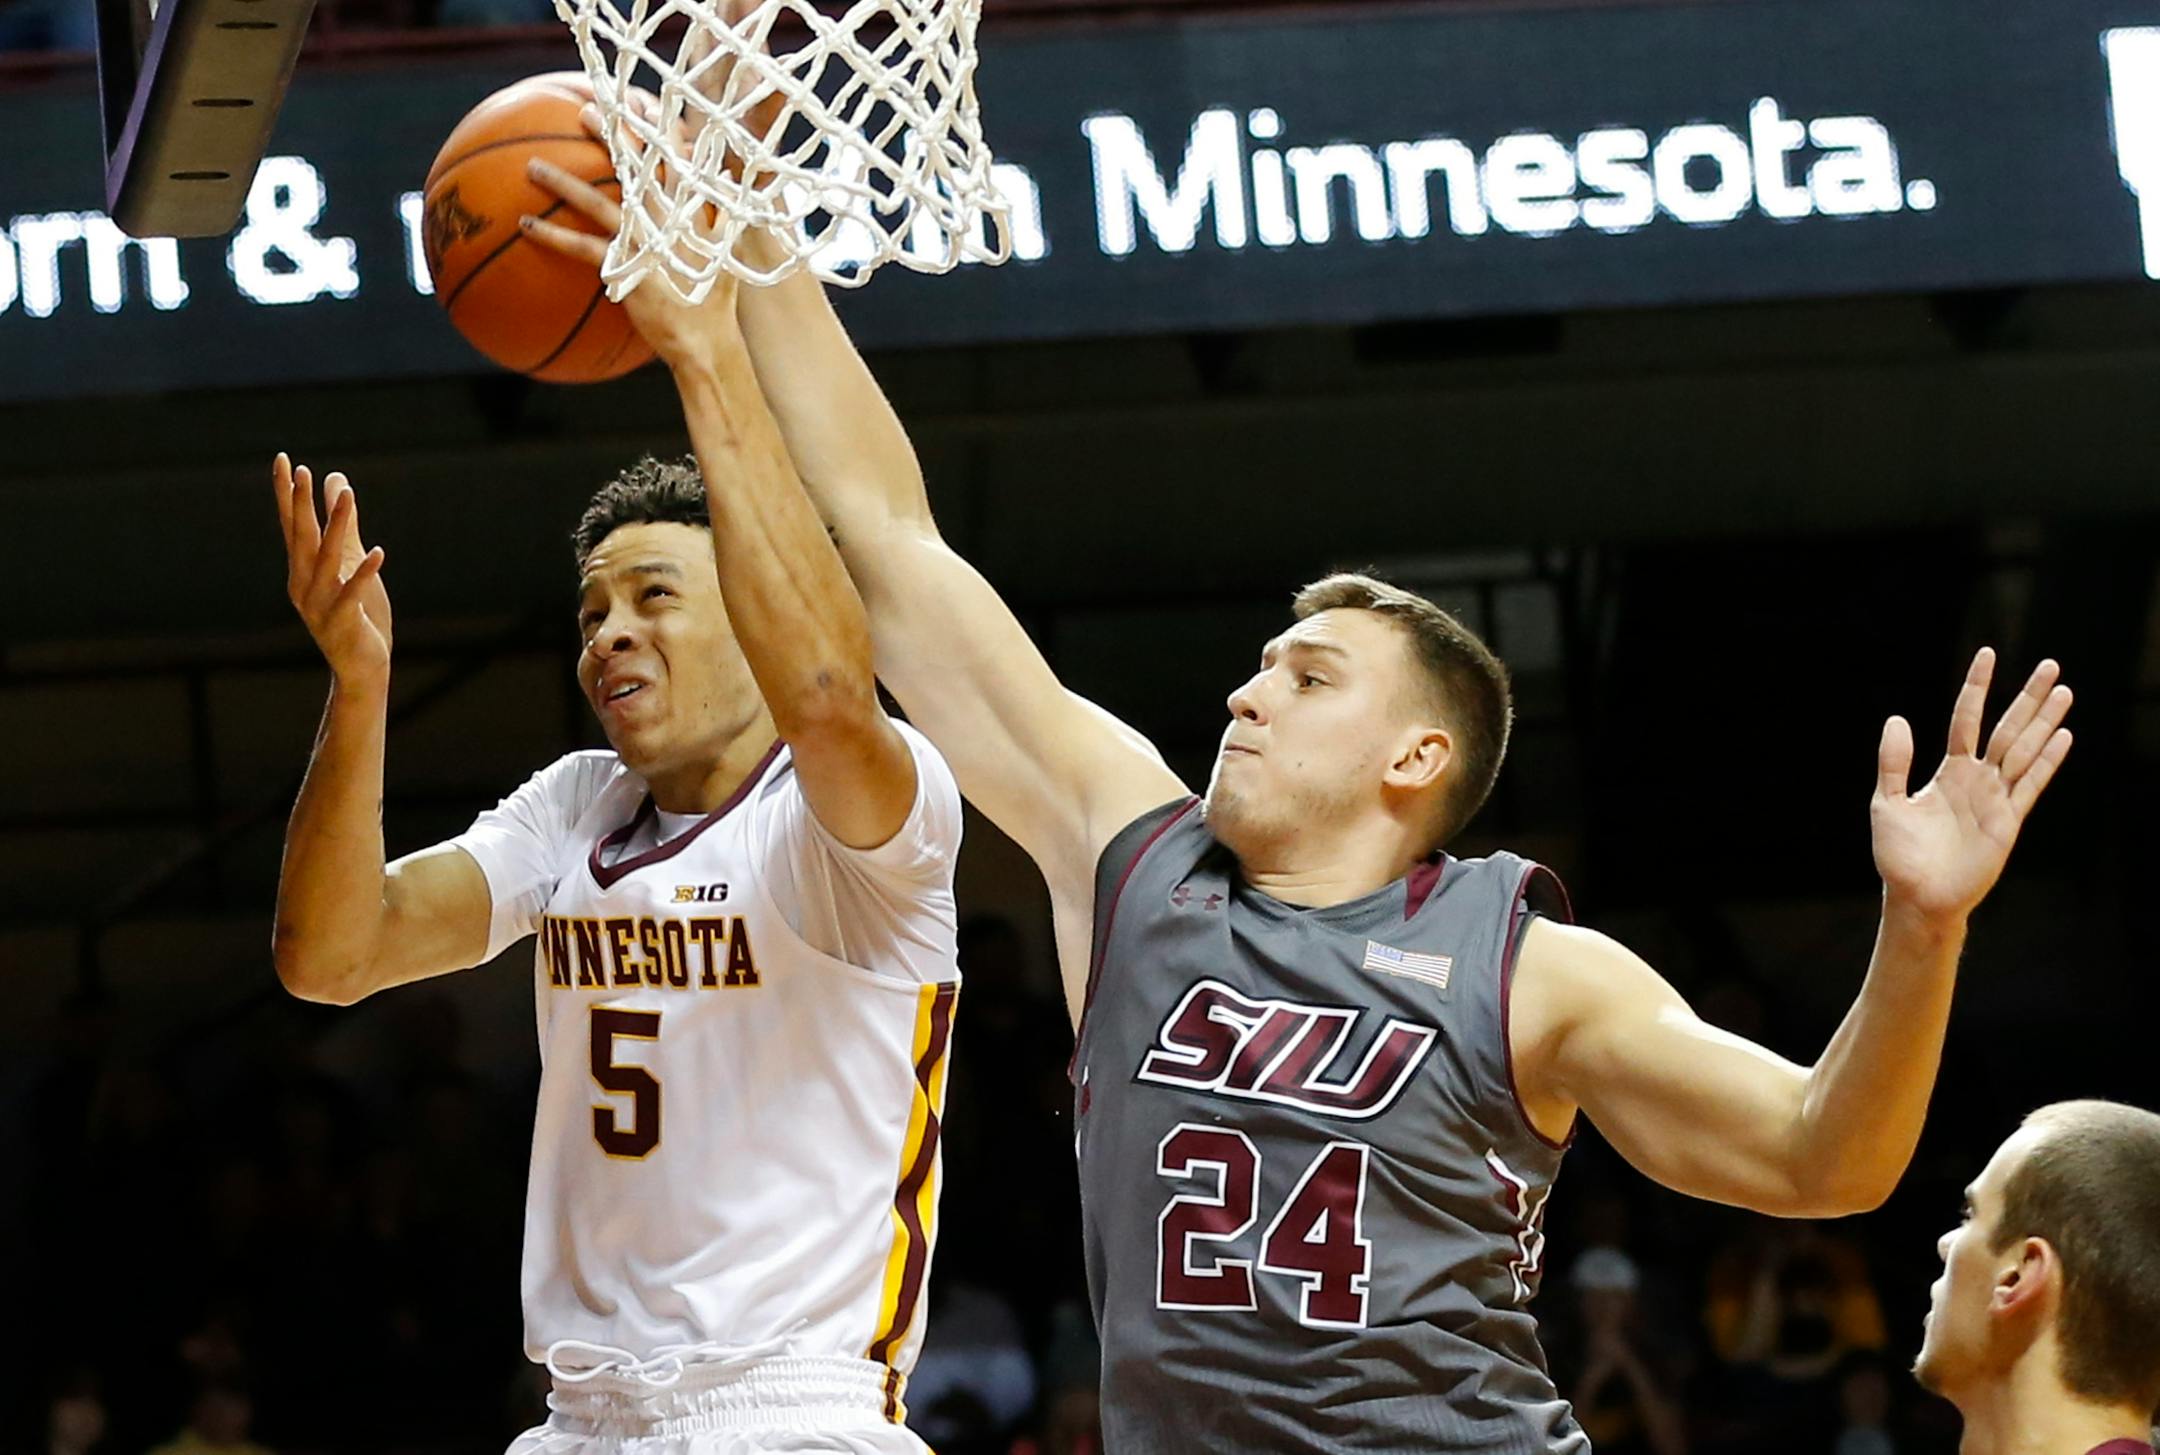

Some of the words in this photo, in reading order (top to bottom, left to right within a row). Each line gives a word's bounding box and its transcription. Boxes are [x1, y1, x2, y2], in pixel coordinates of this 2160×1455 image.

[227, 155, 360, 304] &
[1082, 97, 1937, 256] Minnesota.
[589, 1004, 664, 1161] 5
[1136, 978, 1438, 1119] SIU
[1156, 1122, 1370, 1329] 24
